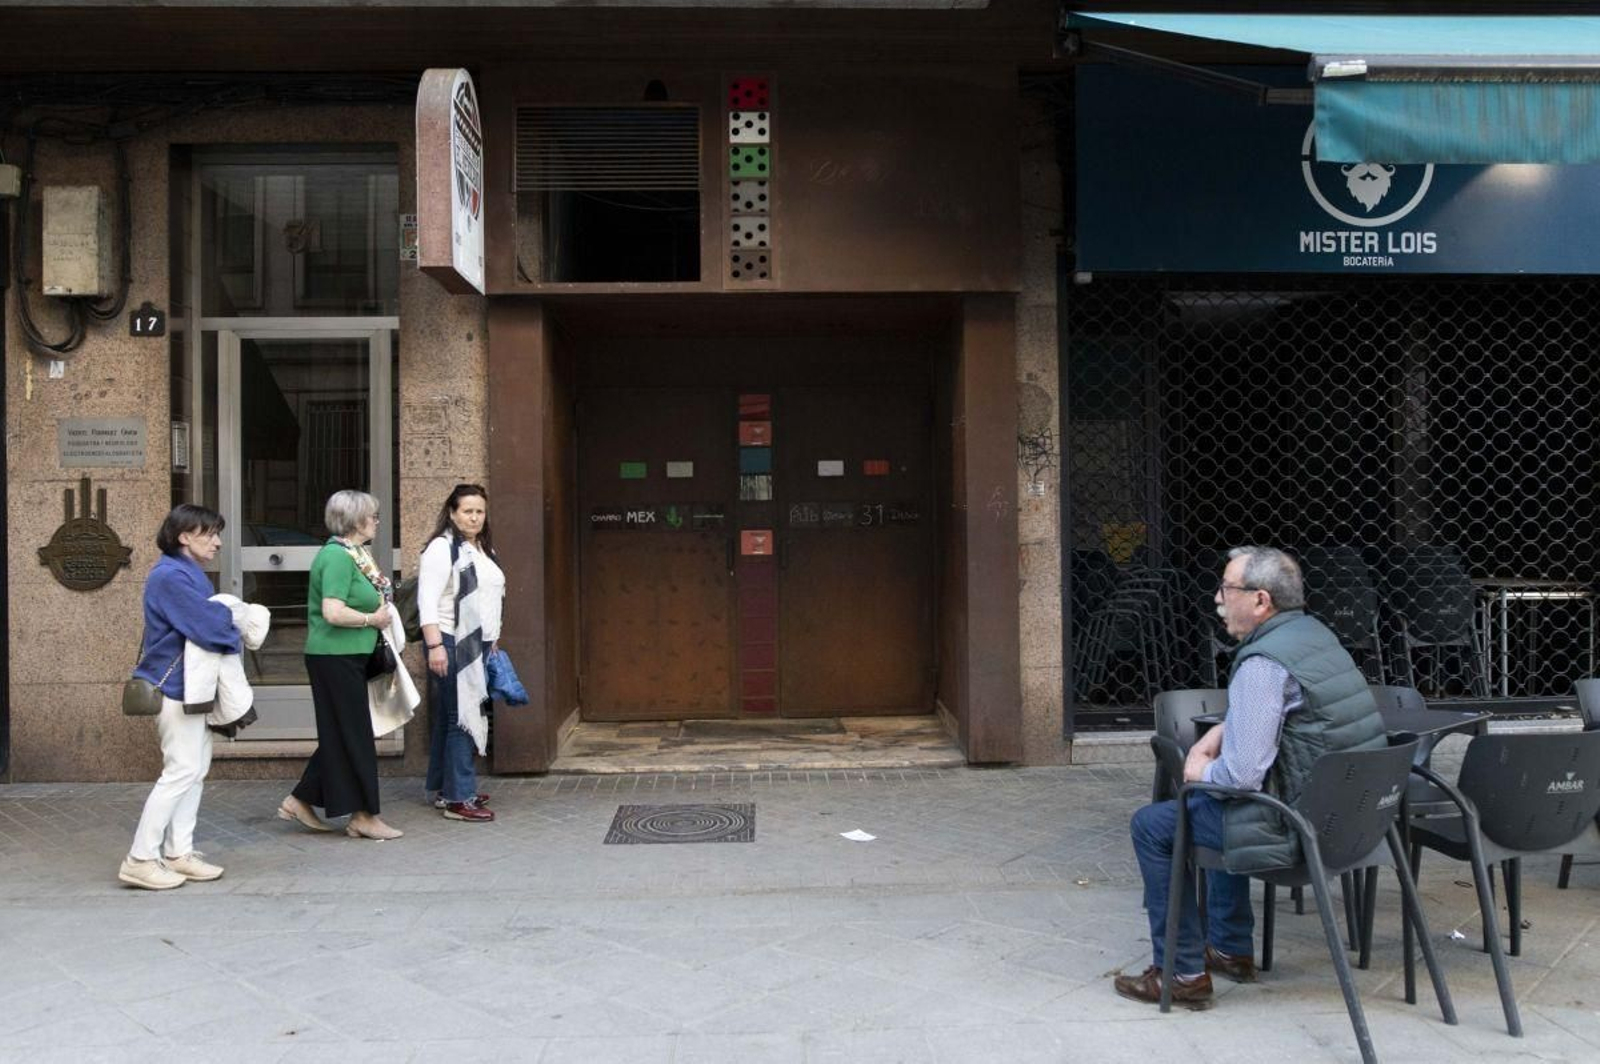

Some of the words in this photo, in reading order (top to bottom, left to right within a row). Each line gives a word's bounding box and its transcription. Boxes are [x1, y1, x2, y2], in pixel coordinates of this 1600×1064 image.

[1300, 231, 1379, 253] MISTER
[1387, 232, 1437, 254] LOIS
[1343, 255, 1394, 267] BOCATERÍA
[136, 317, 158, 332] 17
[626, 511, 656, 523] MEX
[1547, 780, 1584, 791] AMBAR
